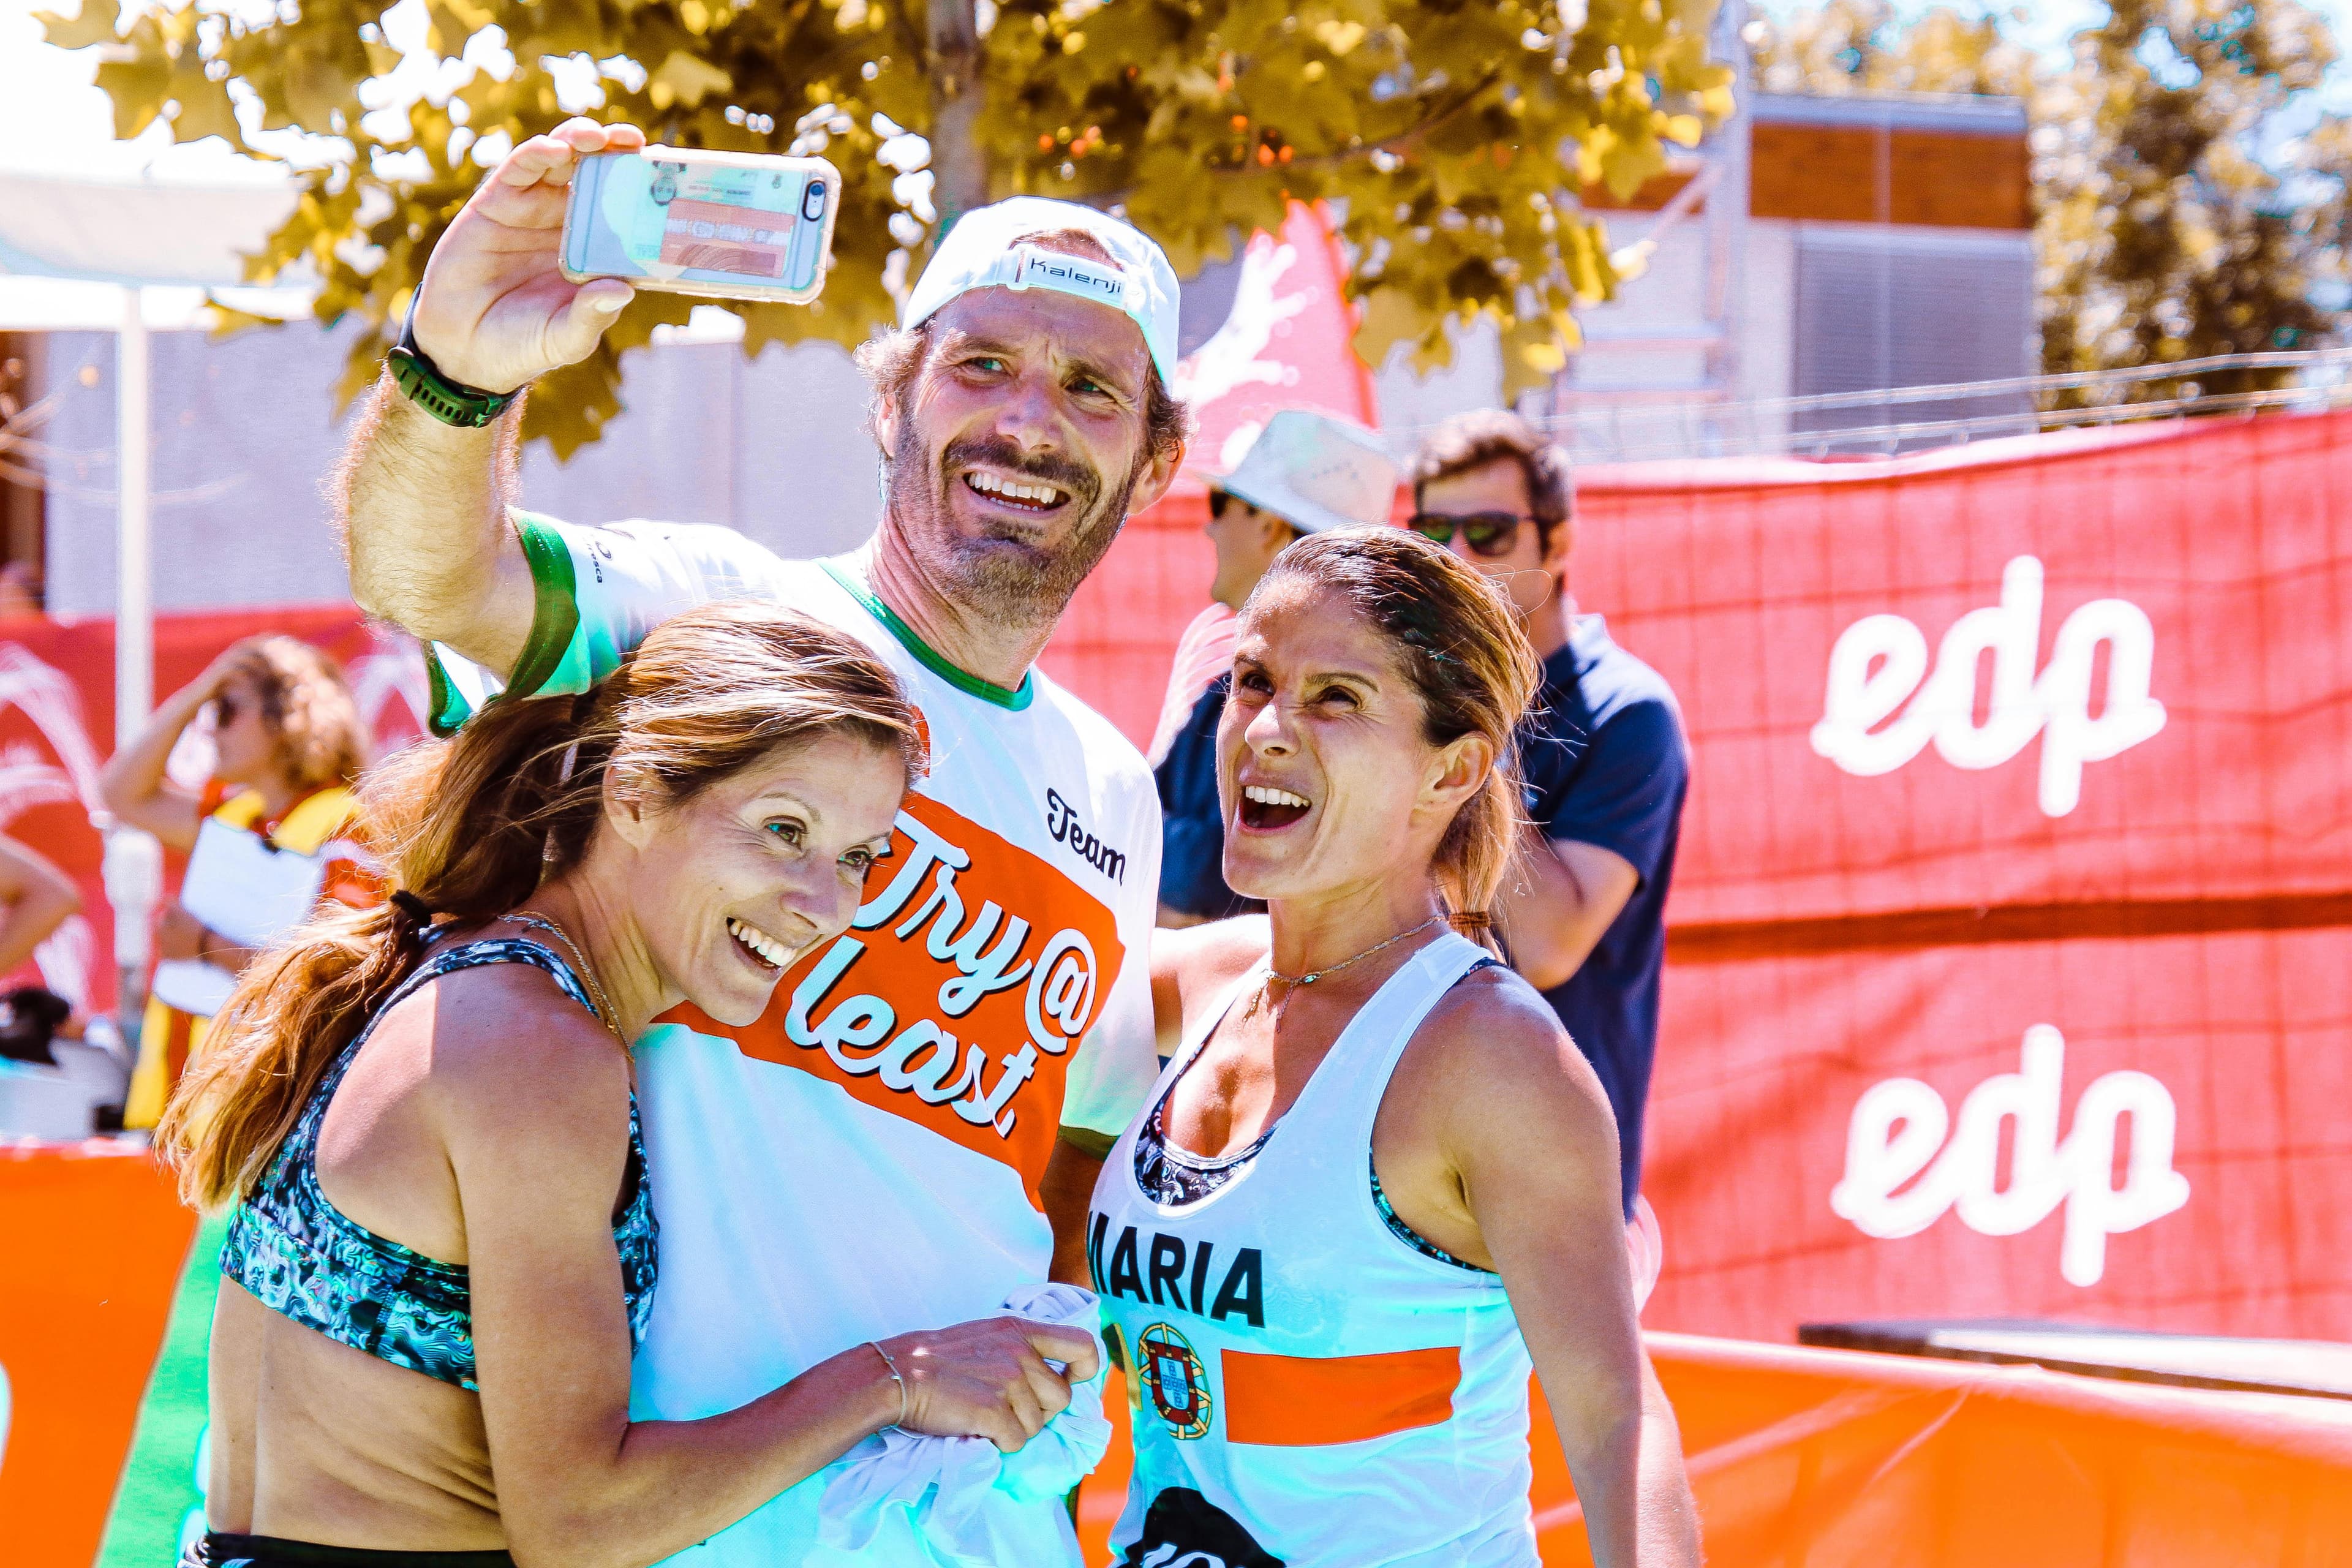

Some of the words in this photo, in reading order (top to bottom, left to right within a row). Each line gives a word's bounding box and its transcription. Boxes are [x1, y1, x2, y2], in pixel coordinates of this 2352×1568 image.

[1030, 257, 1122, 293] Kalenji
[1809, 554, 2168, 818] edp
[1046, 787, 1126, 887] Team
[1830, 1023, 2191, 1287] edp
